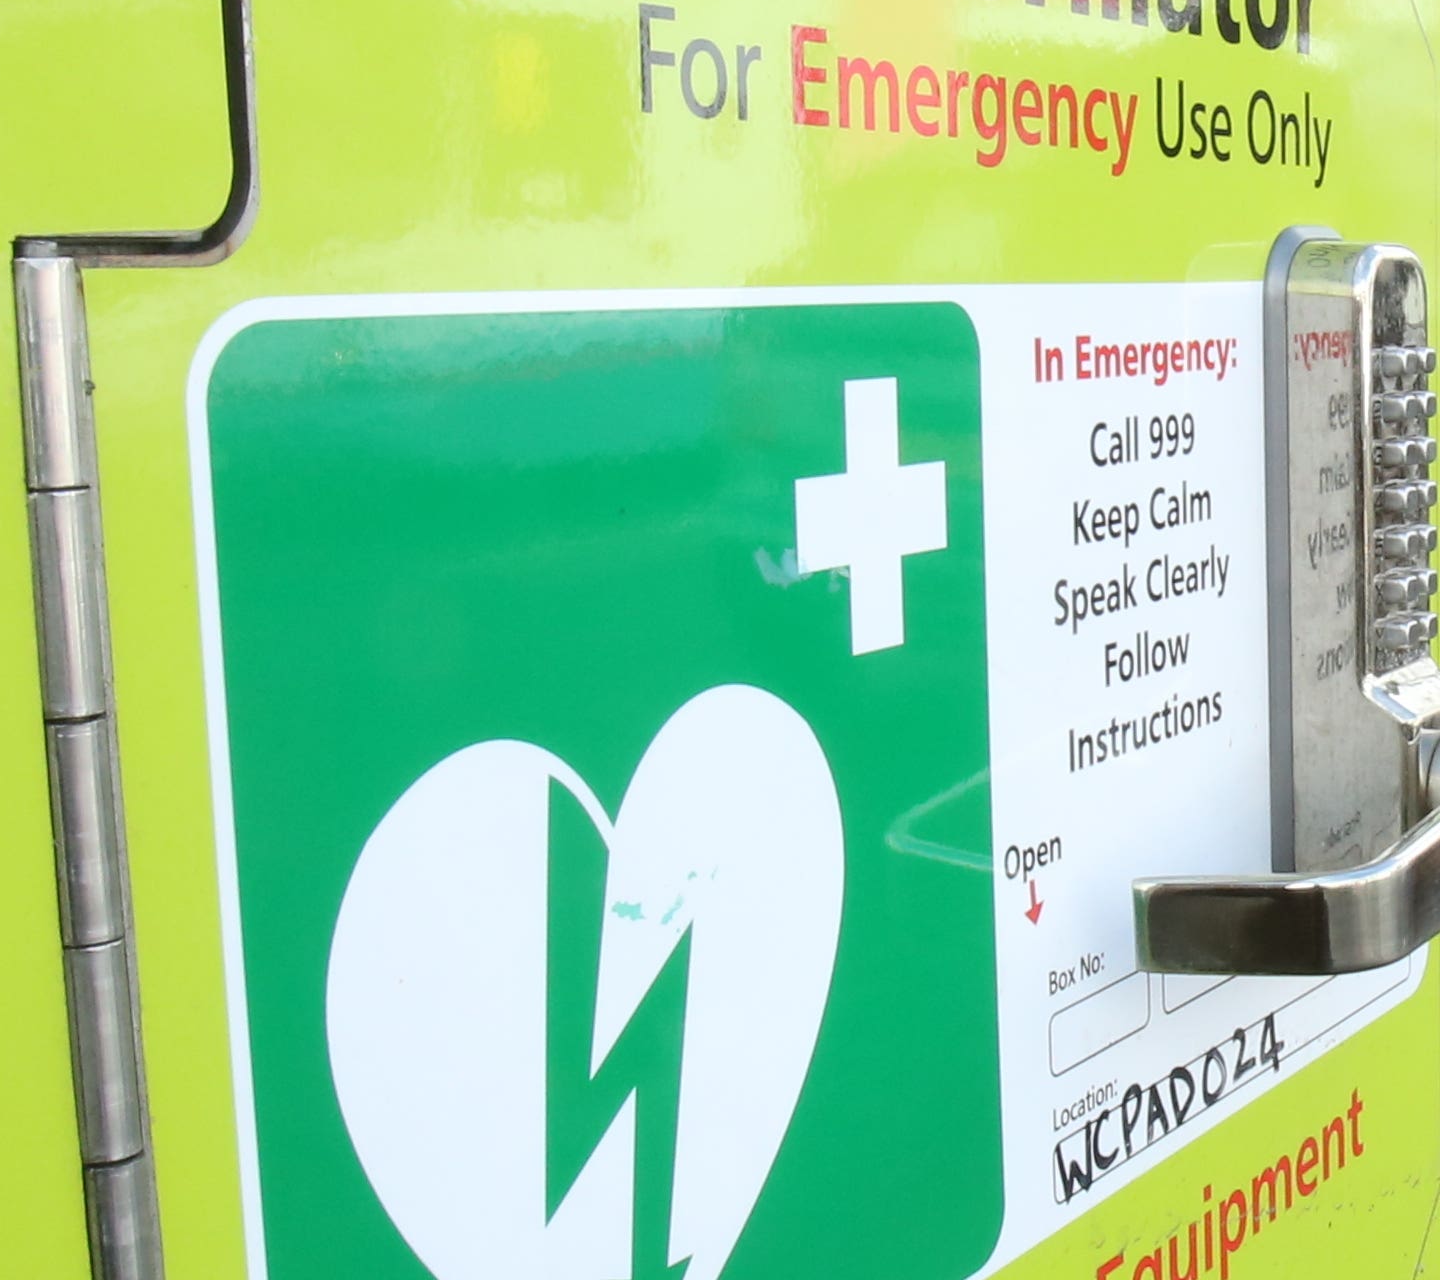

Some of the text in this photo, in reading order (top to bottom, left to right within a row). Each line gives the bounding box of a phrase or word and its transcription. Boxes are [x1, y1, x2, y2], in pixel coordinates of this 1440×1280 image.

[639, 3, 1333, 188] For Emergency Use Only
[1034, 334, 1239, 387] In Emergency:
[1090, 413, 1196, 468] Call 999
[1072, 481, 1213, 547] Keep Calm
[1054, 545, 1230, 635] Speak Clearly
[1104, 631, 1190, 687] Follow
[1068, 688, 1223, 773] Instructions
[1004, 835, 1062, 884] Open
[1048, 952, 1106, 997] Box No:
[1053, 1078, 1119, 1132] Location:
